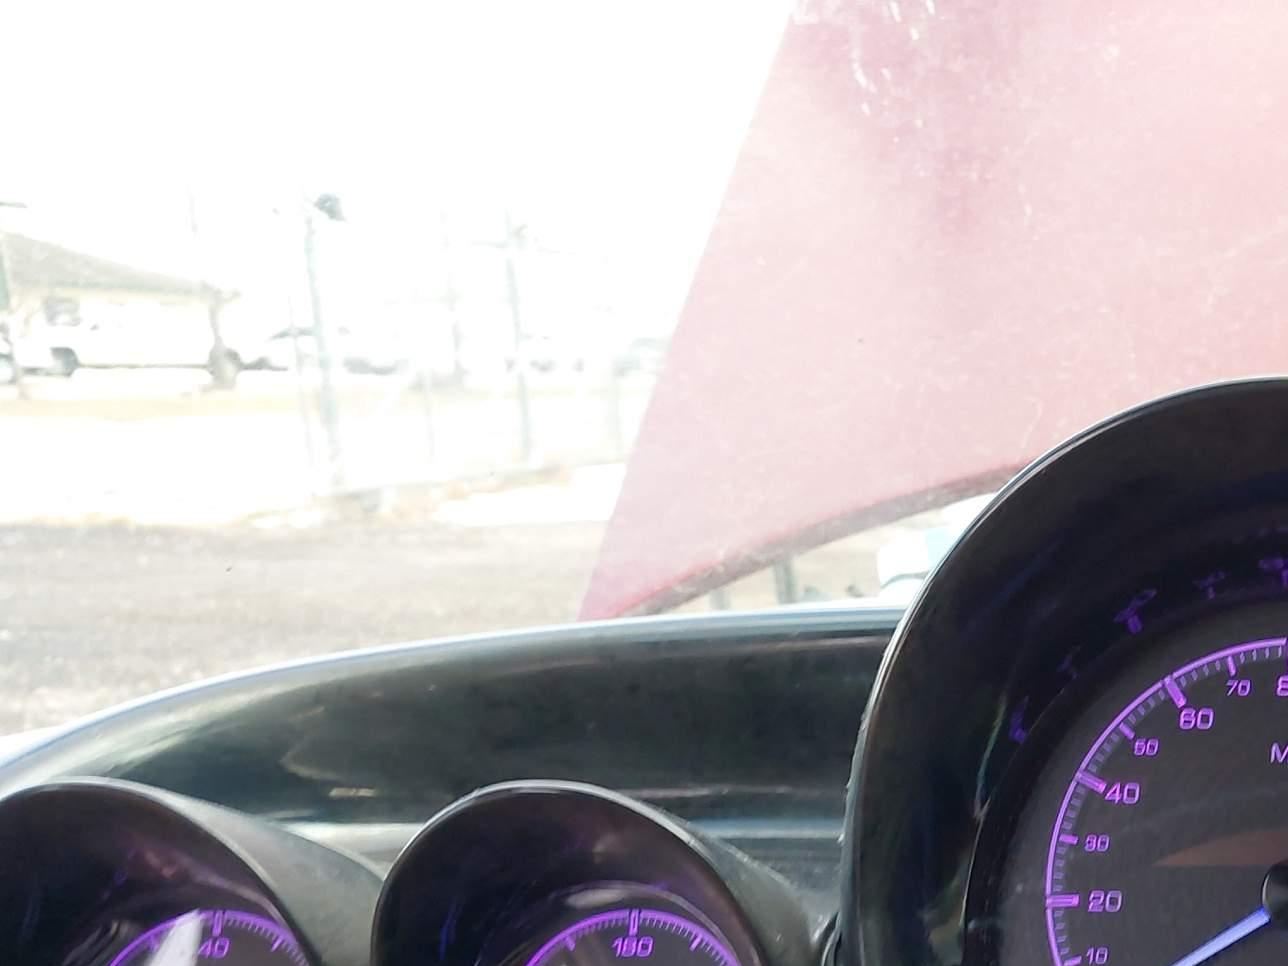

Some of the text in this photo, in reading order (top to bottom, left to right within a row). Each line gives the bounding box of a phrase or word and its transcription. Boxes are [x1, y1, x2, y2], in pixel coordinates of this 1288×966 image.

[1226, 680, 1251, 697] 70
[1179, 708, 1214, 730] 60
[1133, 739, 1159, 756] 50
[1105, 782, 1140, 804] 40
[1084, 835, 1110, 852] 30
[1088, 890, 1122, 912] 20
[199, 938, 230, 959] 40
[612, 937, 653, 958] 180
[1086, 948, 1108, 965] 10
